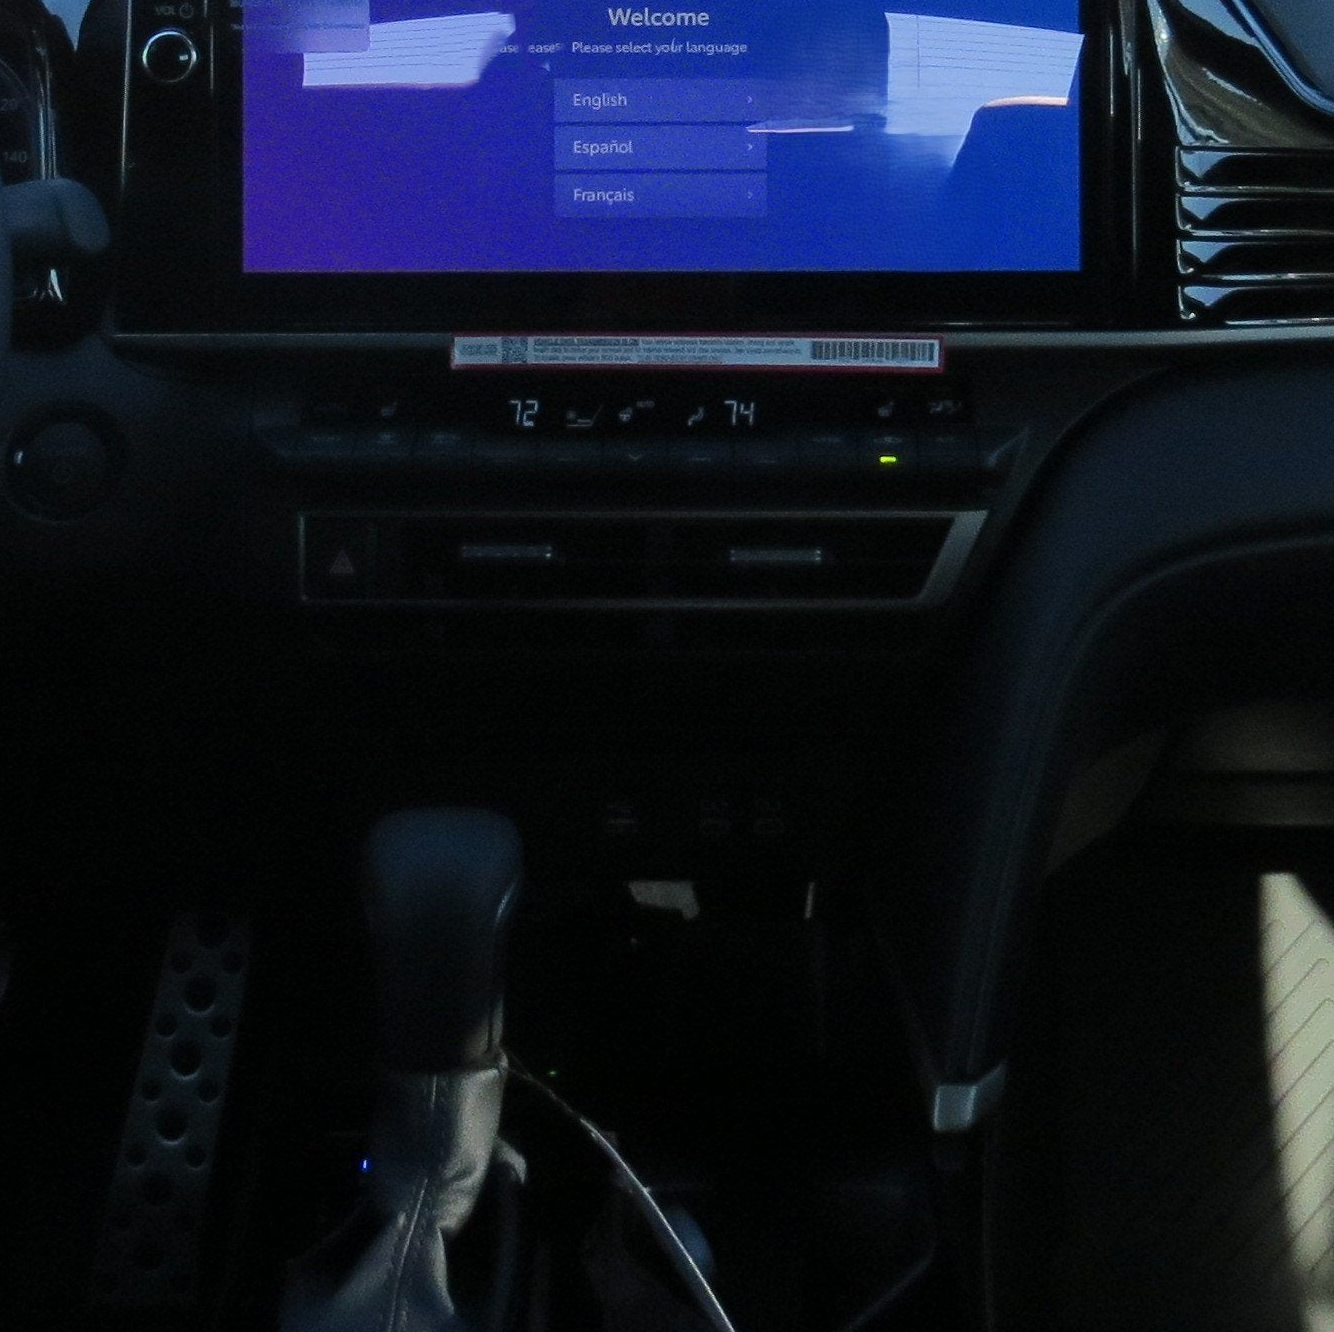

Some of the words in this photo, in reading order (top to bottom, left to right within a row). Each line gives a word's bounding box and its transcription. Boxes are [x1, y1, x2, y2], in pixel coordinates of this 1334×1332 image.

[607, 7, 710, 27] Welcome
[571, 41, 613, 54] Please
[615, 41, 652, 54] select
[655, 43, 684, 57] your
[686, 41, 748, 57] language
[572, 93, 628, 111] English
[572, 139, 634, 157] Español
[573, 187, 635, 206] Français
[510, 400, 540, 427] 72
[723, 400, 756, 427] 74
